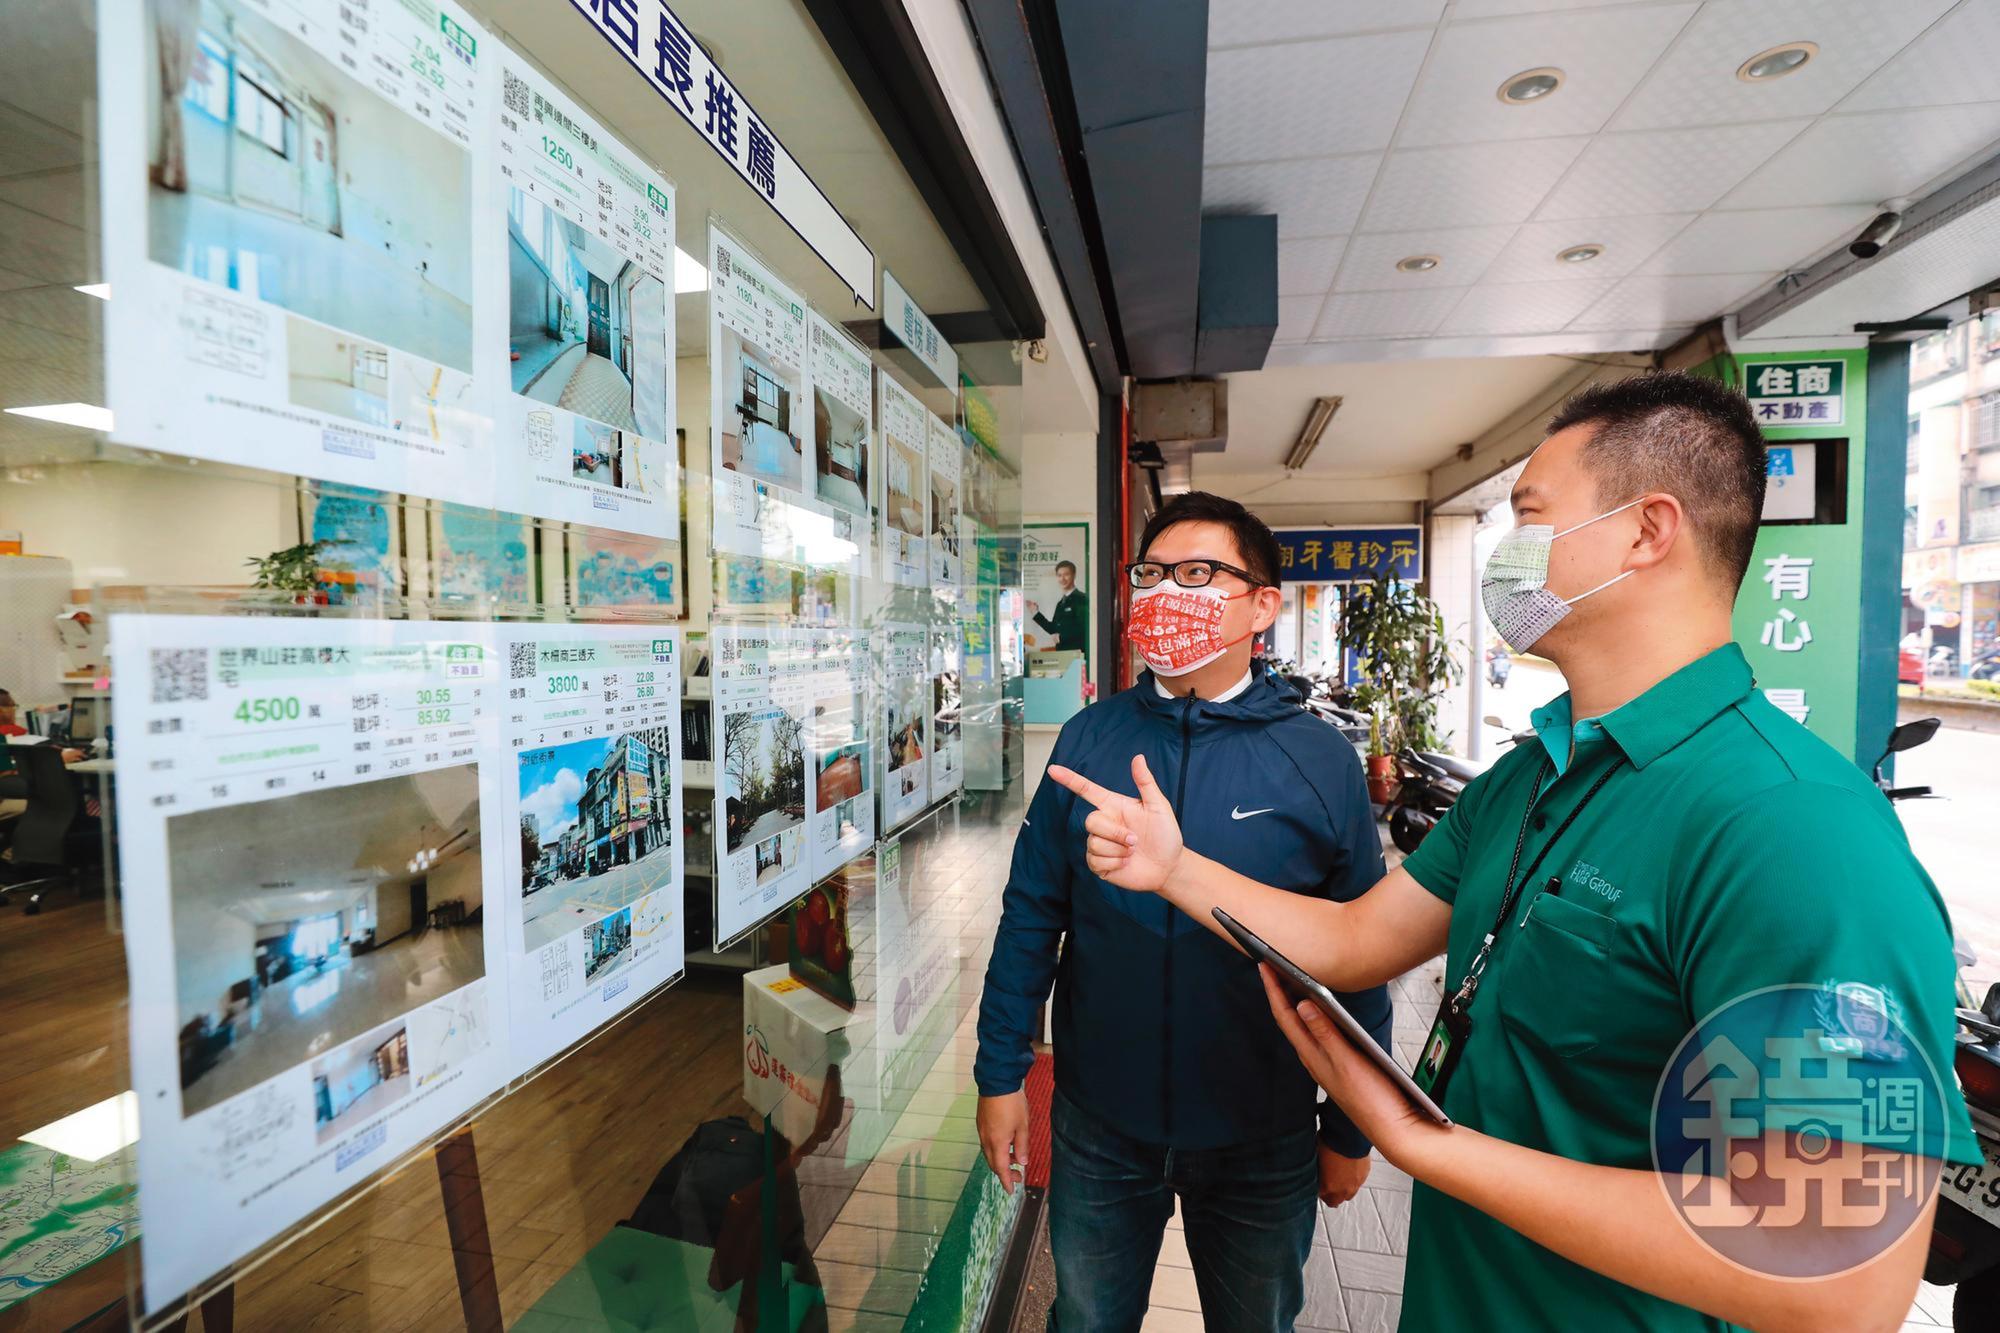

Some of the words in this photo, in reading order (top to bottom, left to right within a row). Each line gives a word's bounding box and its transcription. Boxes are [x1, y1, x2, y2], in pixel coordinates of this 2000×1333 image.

[541, 135, 573, 170] 1250
[632, 218, 652, 240] 30.22
[1757, 366, 1832, 395] 住商
[1760, 401, 1829, 420] 不動產
[548, 675, 579, 695] 3800
[636, 671, 655, 684] 22.08
[415, 688, 451, 705] 30.55
[636, 686, 655, 698] 26.80
[233, 696, 301, 724] 4500
[416, 708, 451, 726] 85.92
[539, 733, 546, 743] 2
[311, 770, 327, 782] 14
